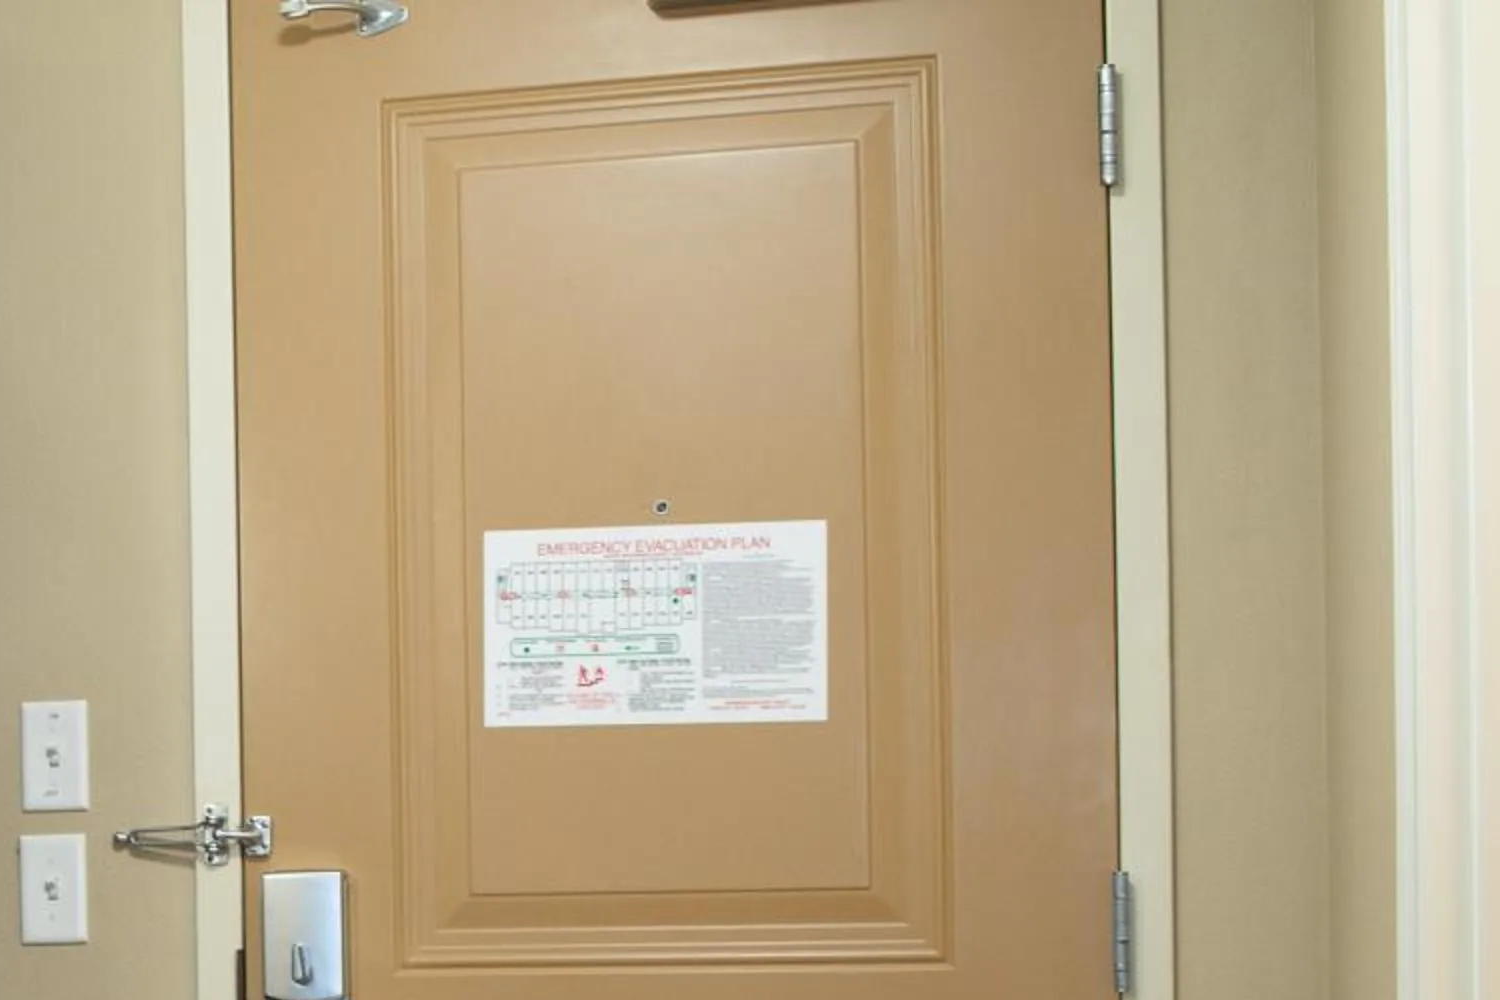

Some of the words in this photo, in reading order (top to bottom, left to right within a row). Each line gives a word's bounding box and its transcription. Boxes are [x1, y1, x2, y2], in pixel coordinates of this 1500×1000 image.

[537, 541, 631, 556] EMERGENCY
[634, 538, 727, 553] EVACUATION
[730, 536, 771, 550] PLAN
